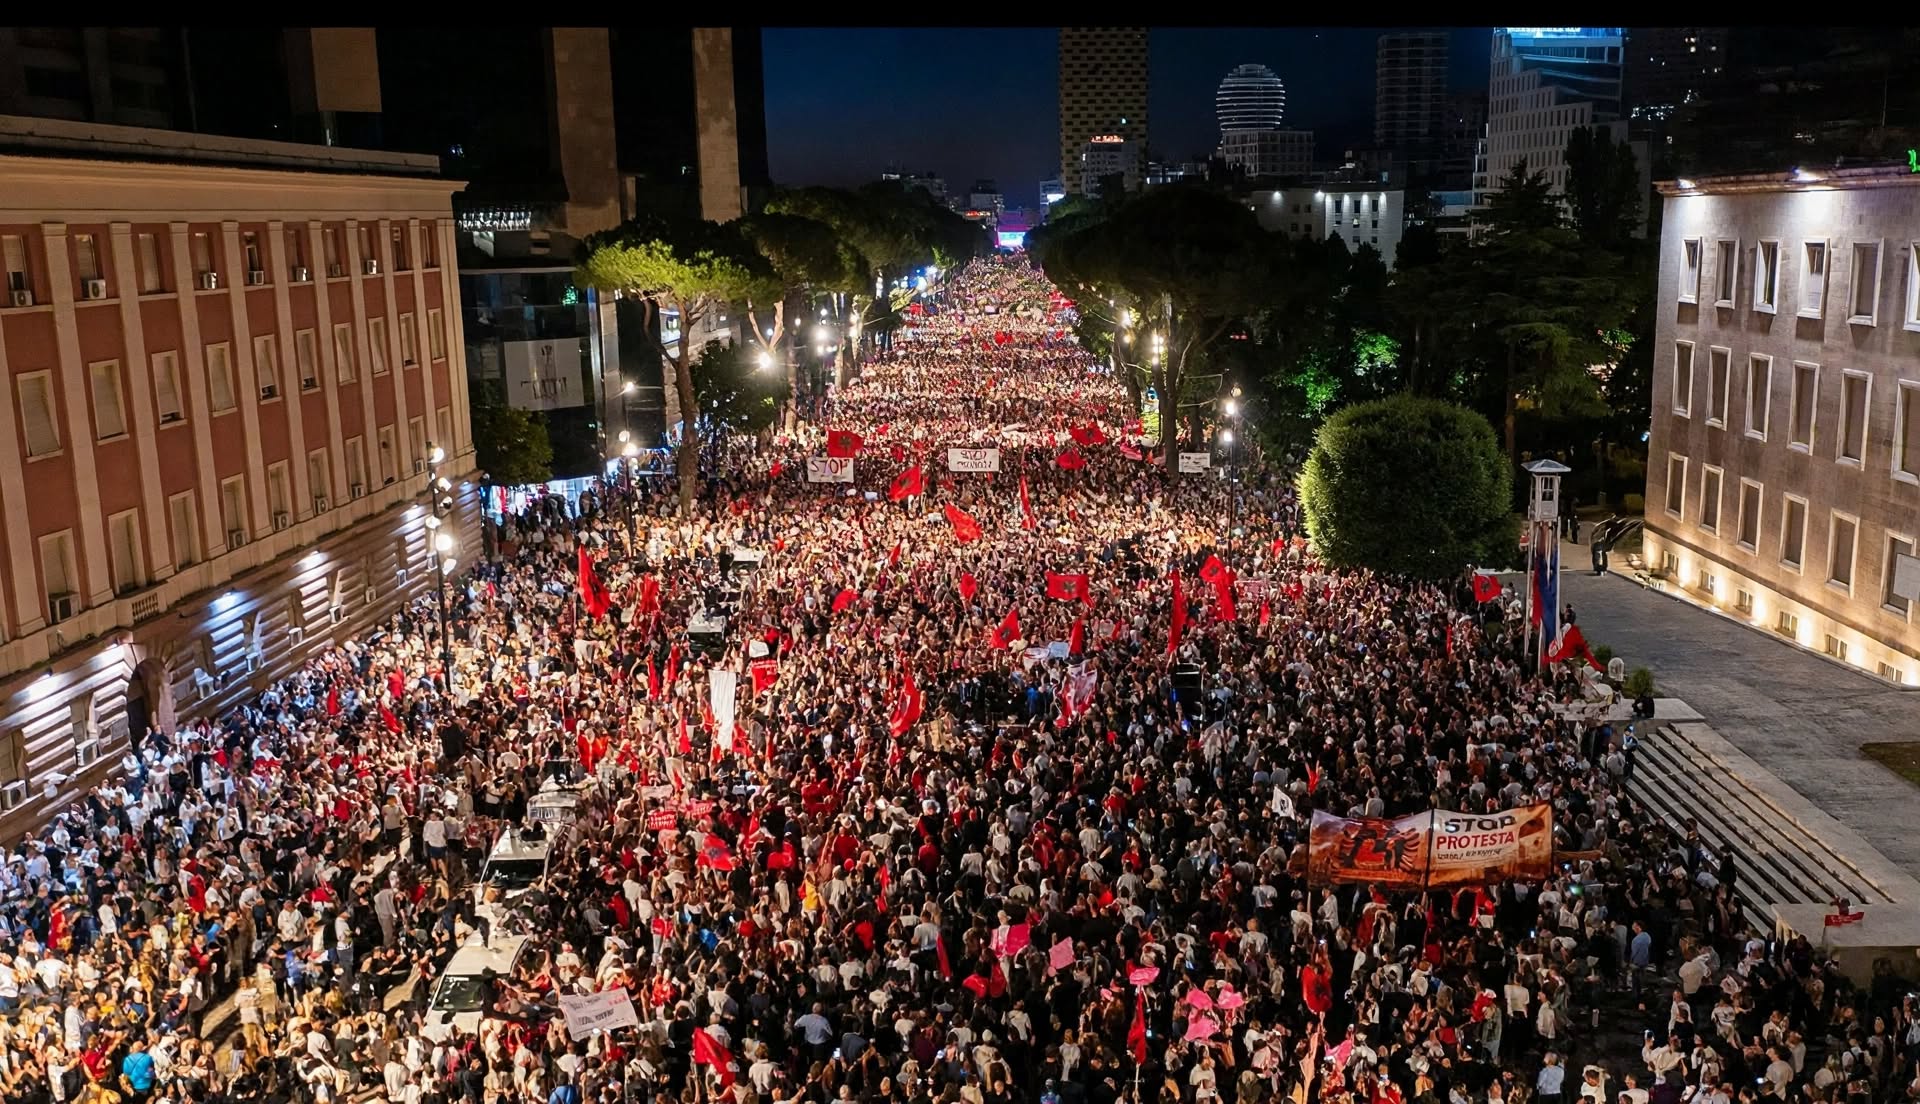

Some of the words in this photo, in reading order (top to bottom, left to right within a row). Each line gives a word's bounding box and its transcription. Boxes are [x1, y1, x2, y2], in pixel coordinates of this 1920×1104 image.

[810, 458, 850, 475] STOP
[1444, 815, 1517, 834] STOP
[1436, 831, 1515, 850] PROTESTA
